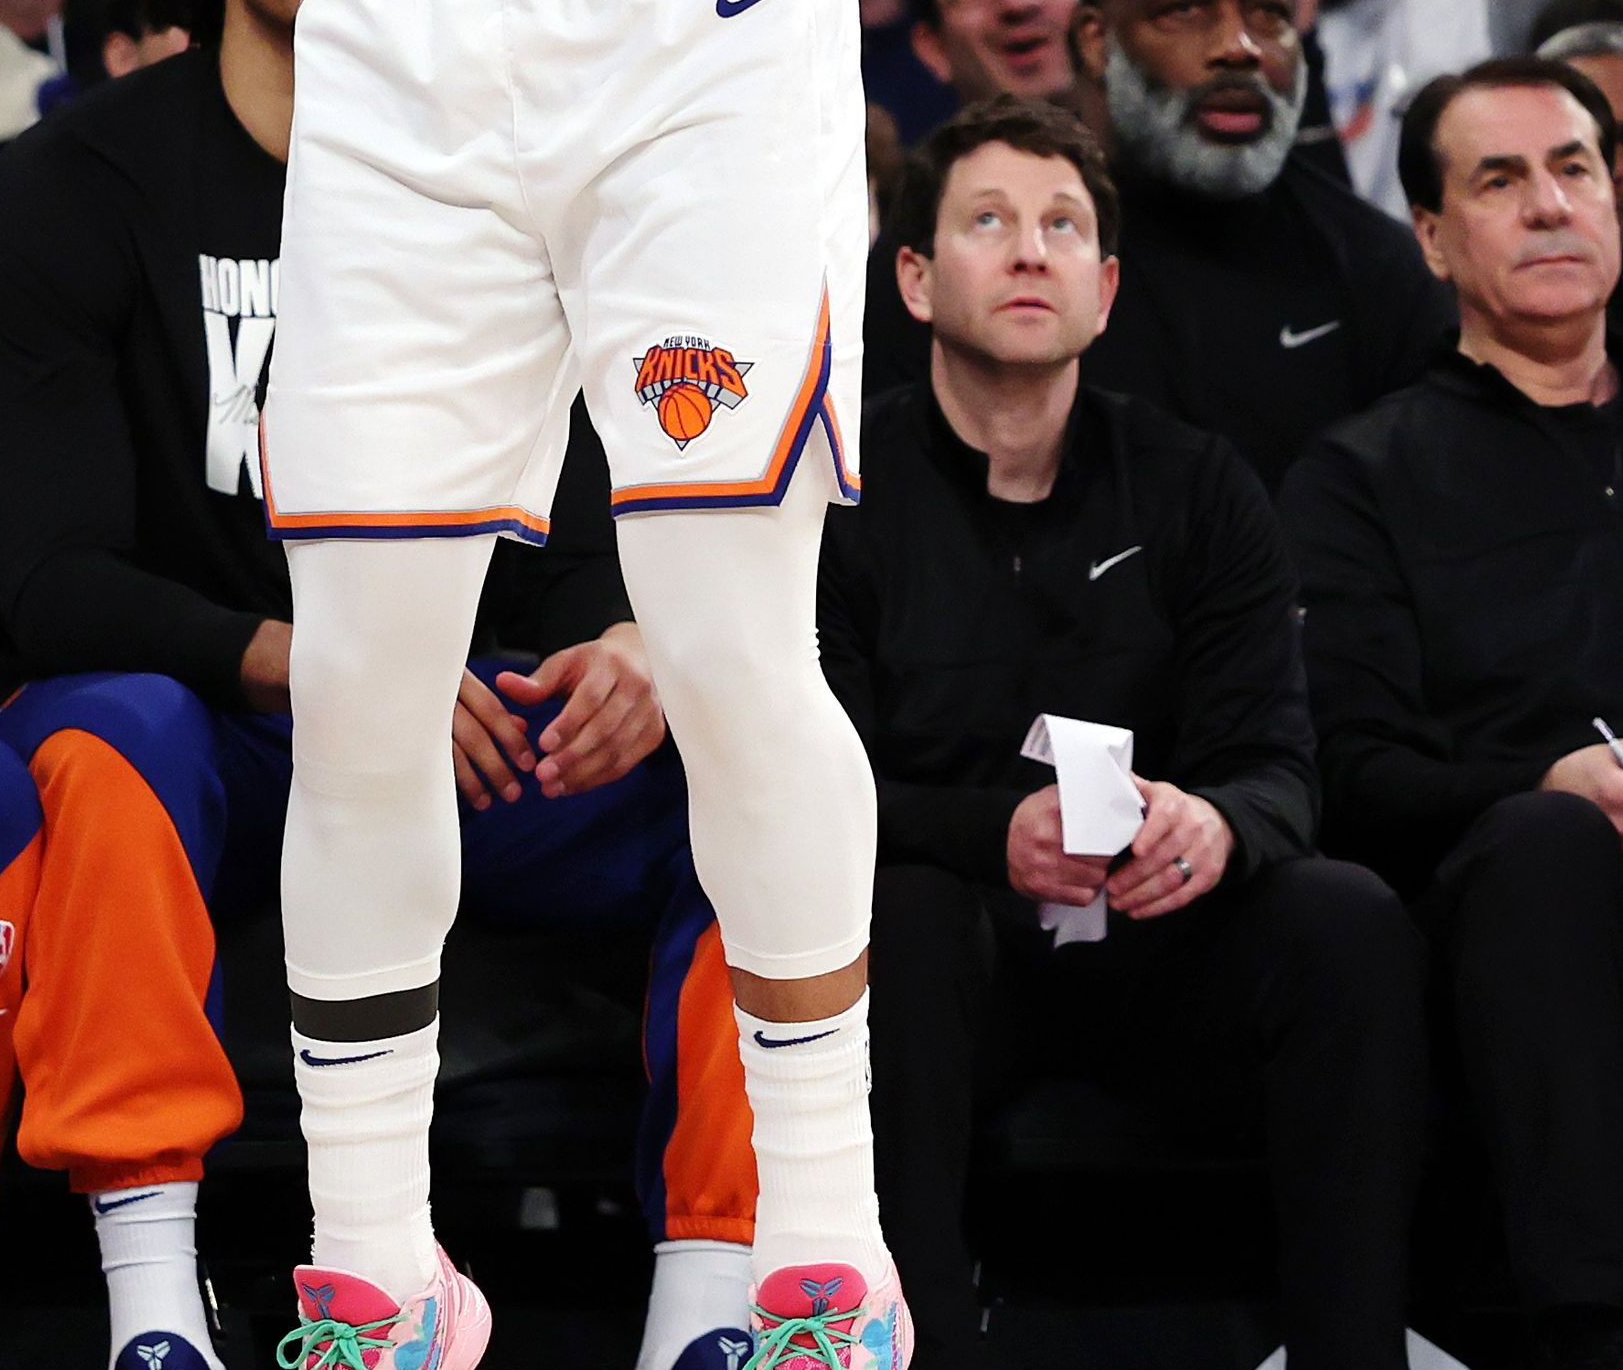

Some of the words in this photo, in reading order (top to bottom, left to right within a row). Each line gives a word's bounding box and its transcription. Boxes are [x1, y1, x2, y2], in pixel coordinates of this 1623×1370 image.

[663, 335, 682, 348] NEW
[685, 336, 711, 350] YORK
[635, 344, 748, 399] KNICKS
